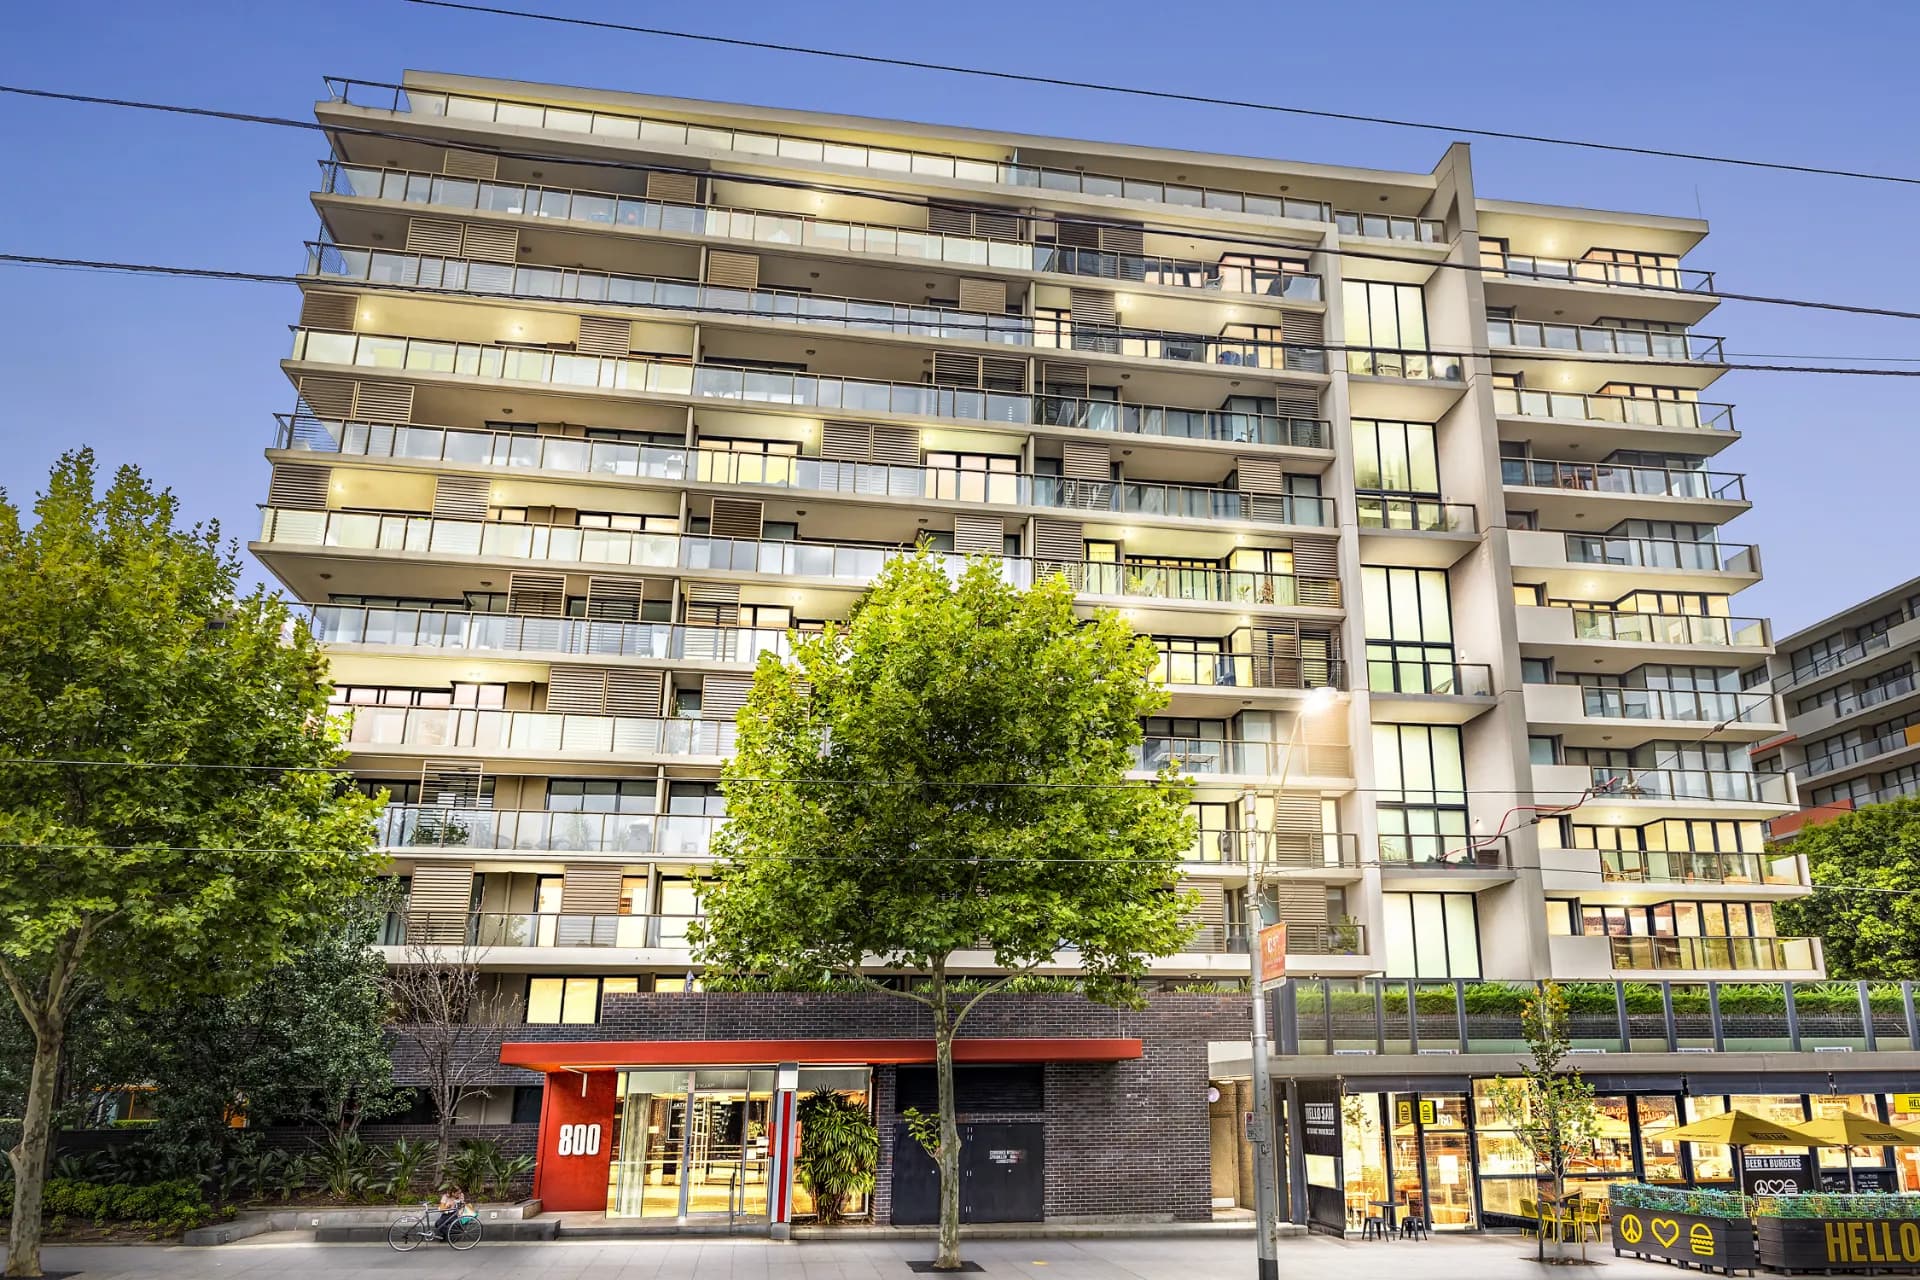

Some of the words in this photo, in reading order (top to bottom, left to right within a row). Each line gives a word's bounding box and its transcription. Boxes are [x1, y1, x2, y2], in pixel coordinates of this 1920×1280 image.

[1305, 1107, 1321, 1120] HELLO
[1321, 1107, 1334, 1120] SAM
[558, 1124, 601, 1155] 800
[1745, 1159, 1762, 1168] BEER
[1769, 1158, 1801, 1168] BURGERS
[1825, 1222, 1920, 1263] HELLO
